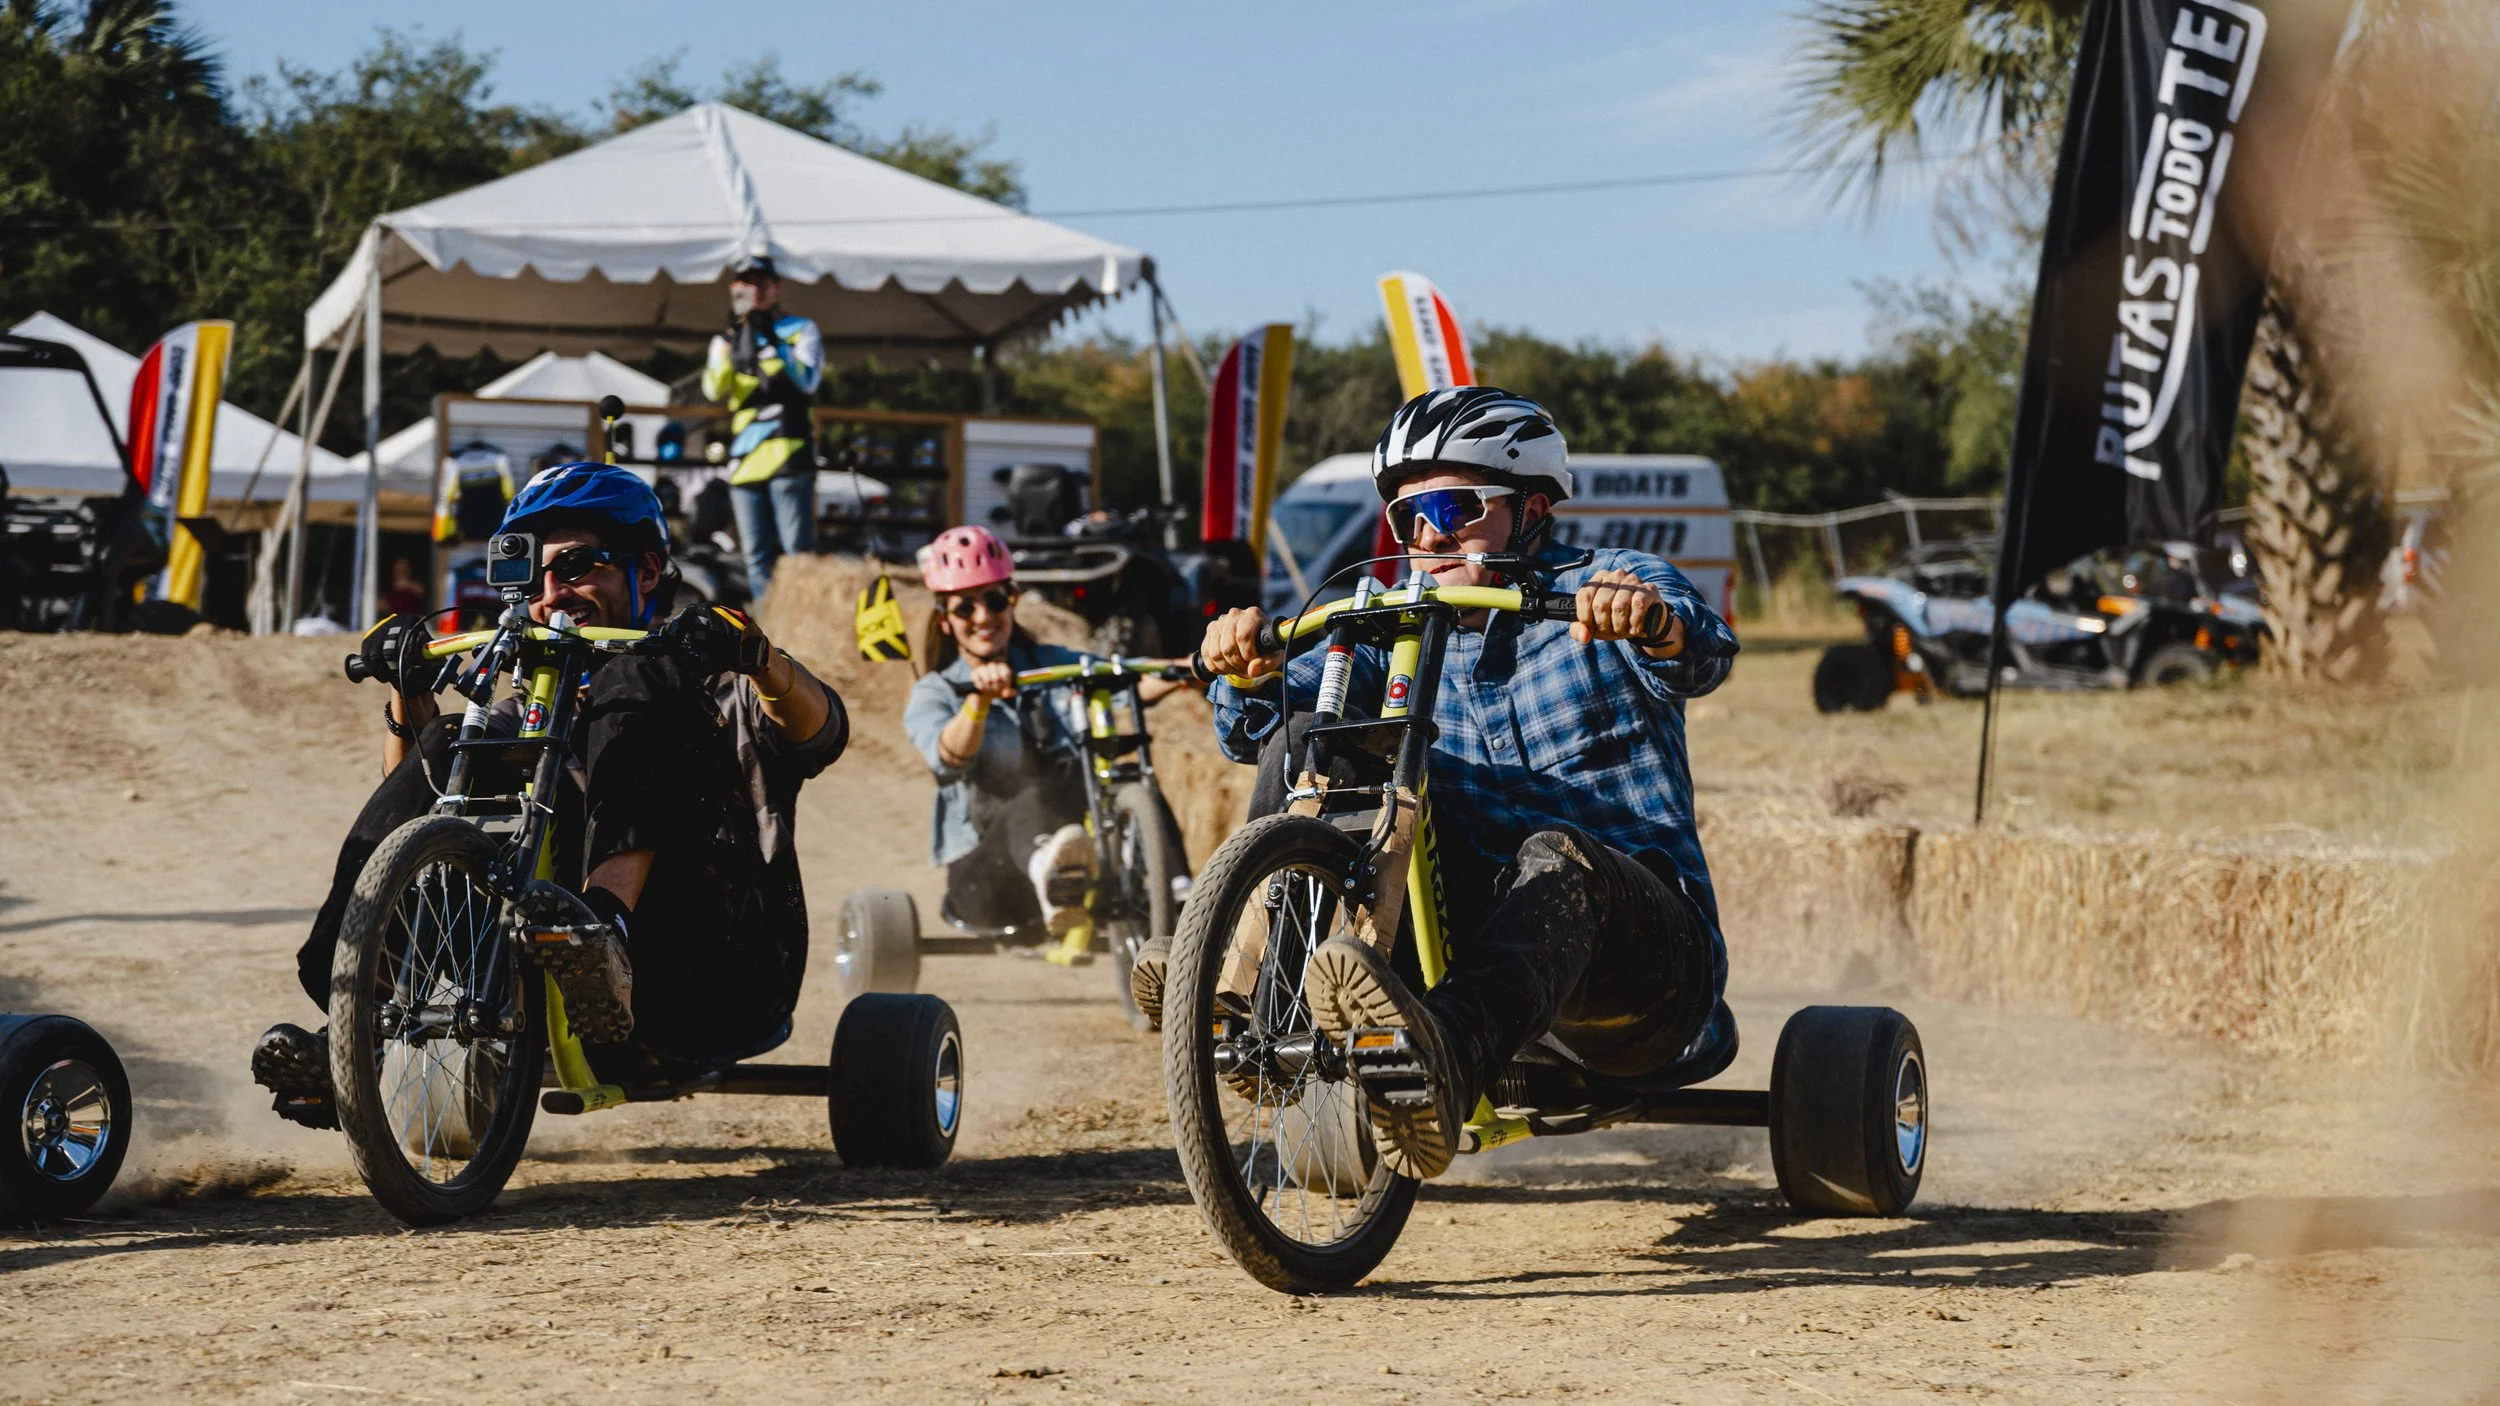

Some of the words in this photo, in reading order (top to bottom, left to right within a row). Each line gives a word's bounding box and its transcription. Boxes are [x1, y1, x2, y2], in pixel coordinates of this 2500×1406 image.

[2095, 255, 2182, 481] RUTAS
[2147, 118, 2214, 243] TODO
[1592, 472, 1690, 497] BOATS
[1552, 519, 1688, 554] n-am
